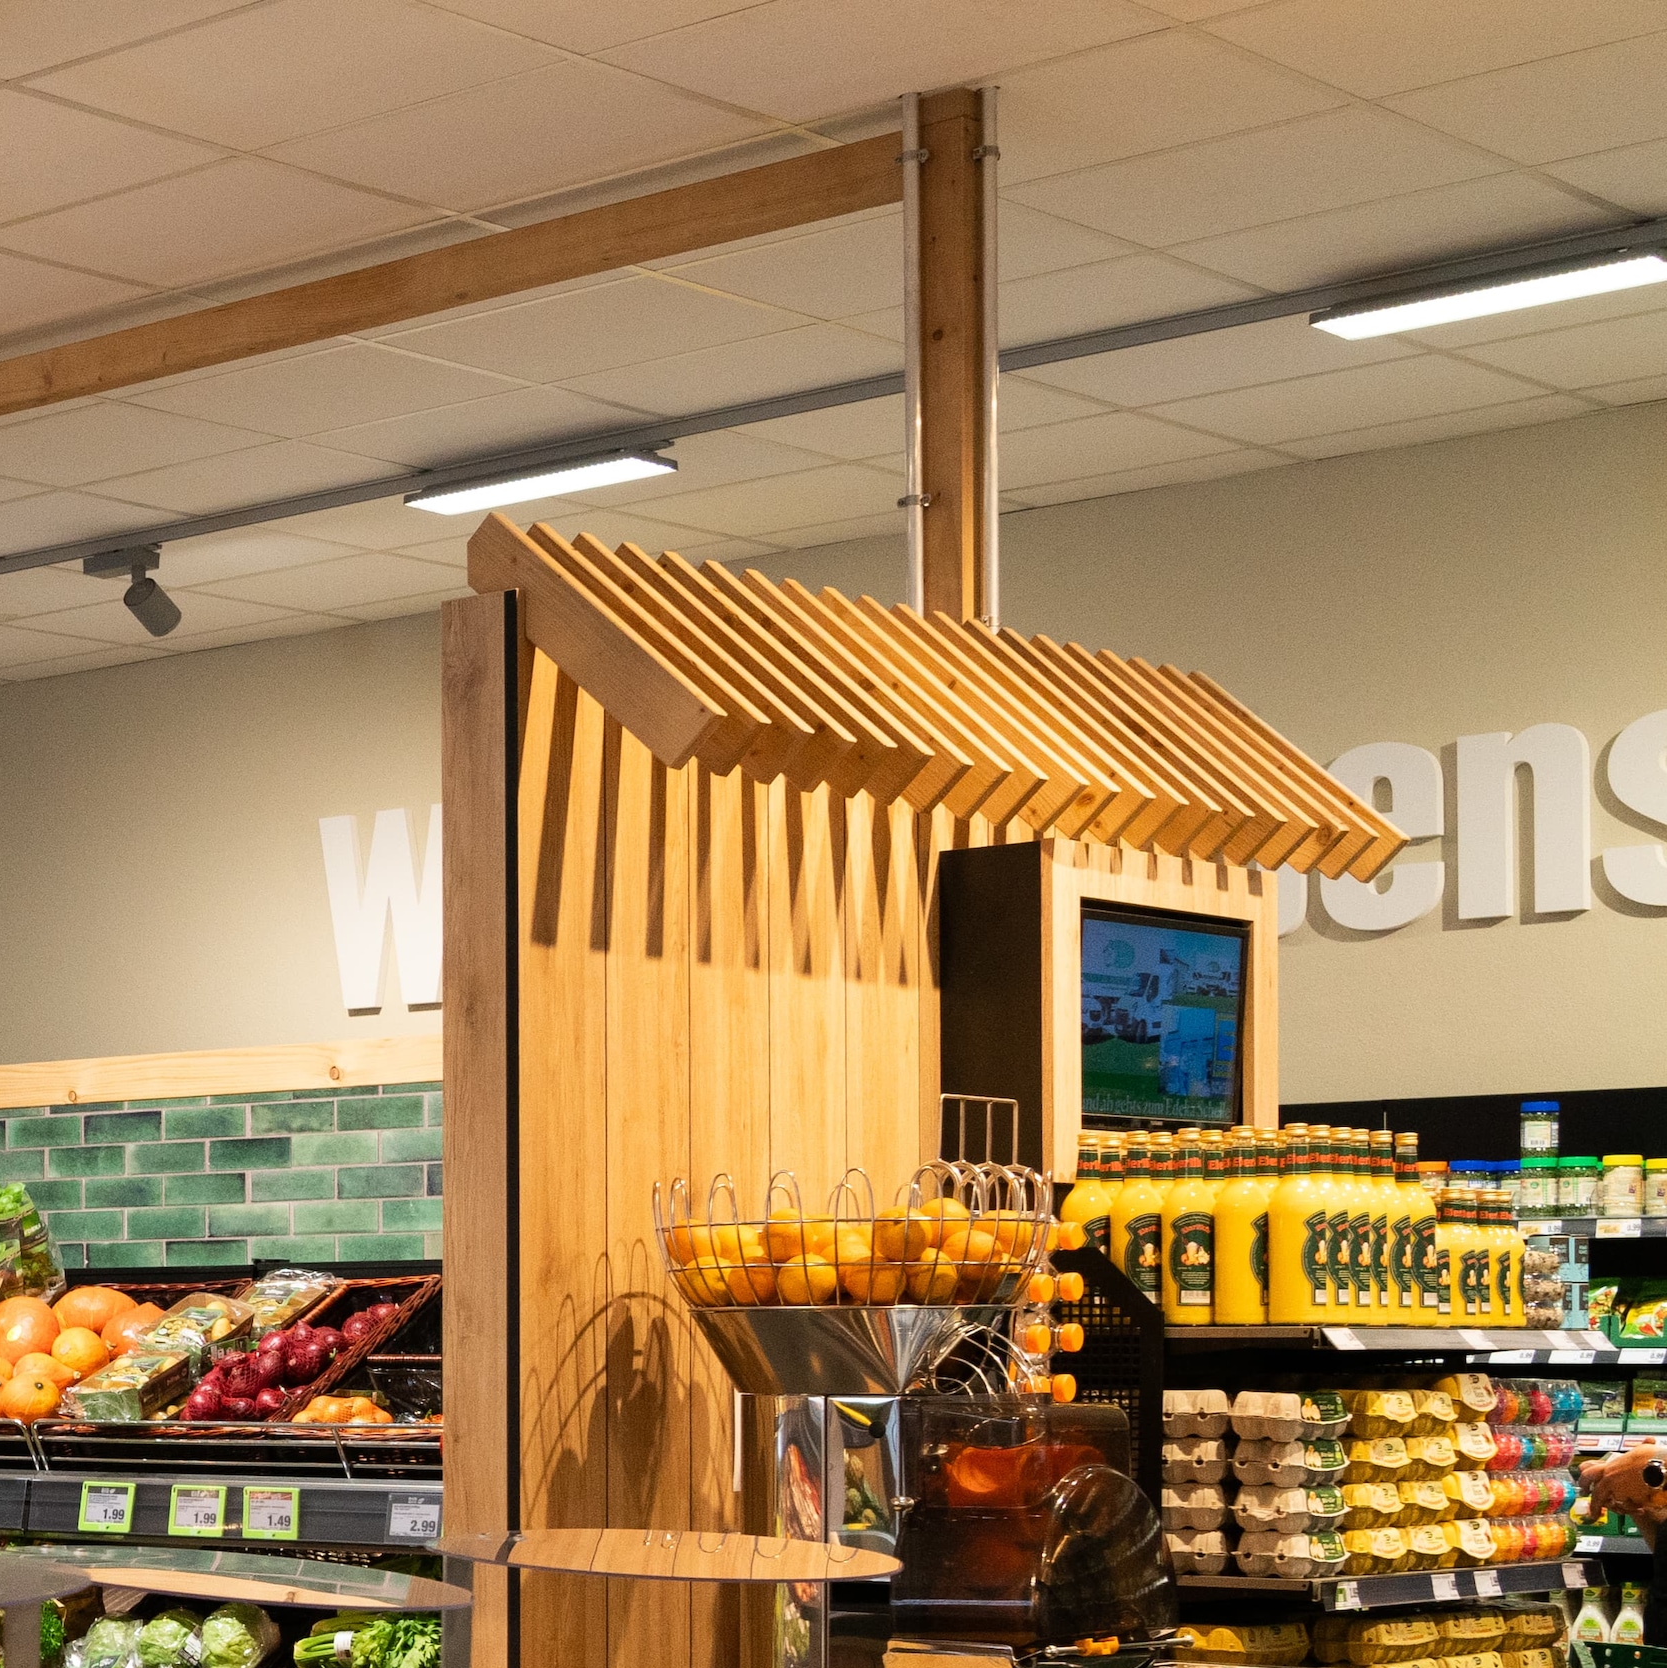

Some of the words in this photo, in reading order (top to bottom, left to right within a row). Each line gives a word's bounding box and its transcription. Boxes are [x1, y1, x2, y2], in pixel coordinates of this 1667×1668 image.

[103, 1508, 125, 1520] 1.99
[194, 1513, 216, 1524] 1.99
[267, 1514, 291, 1527] 1.49
[410, 1520, 436, 1533] 2.99
